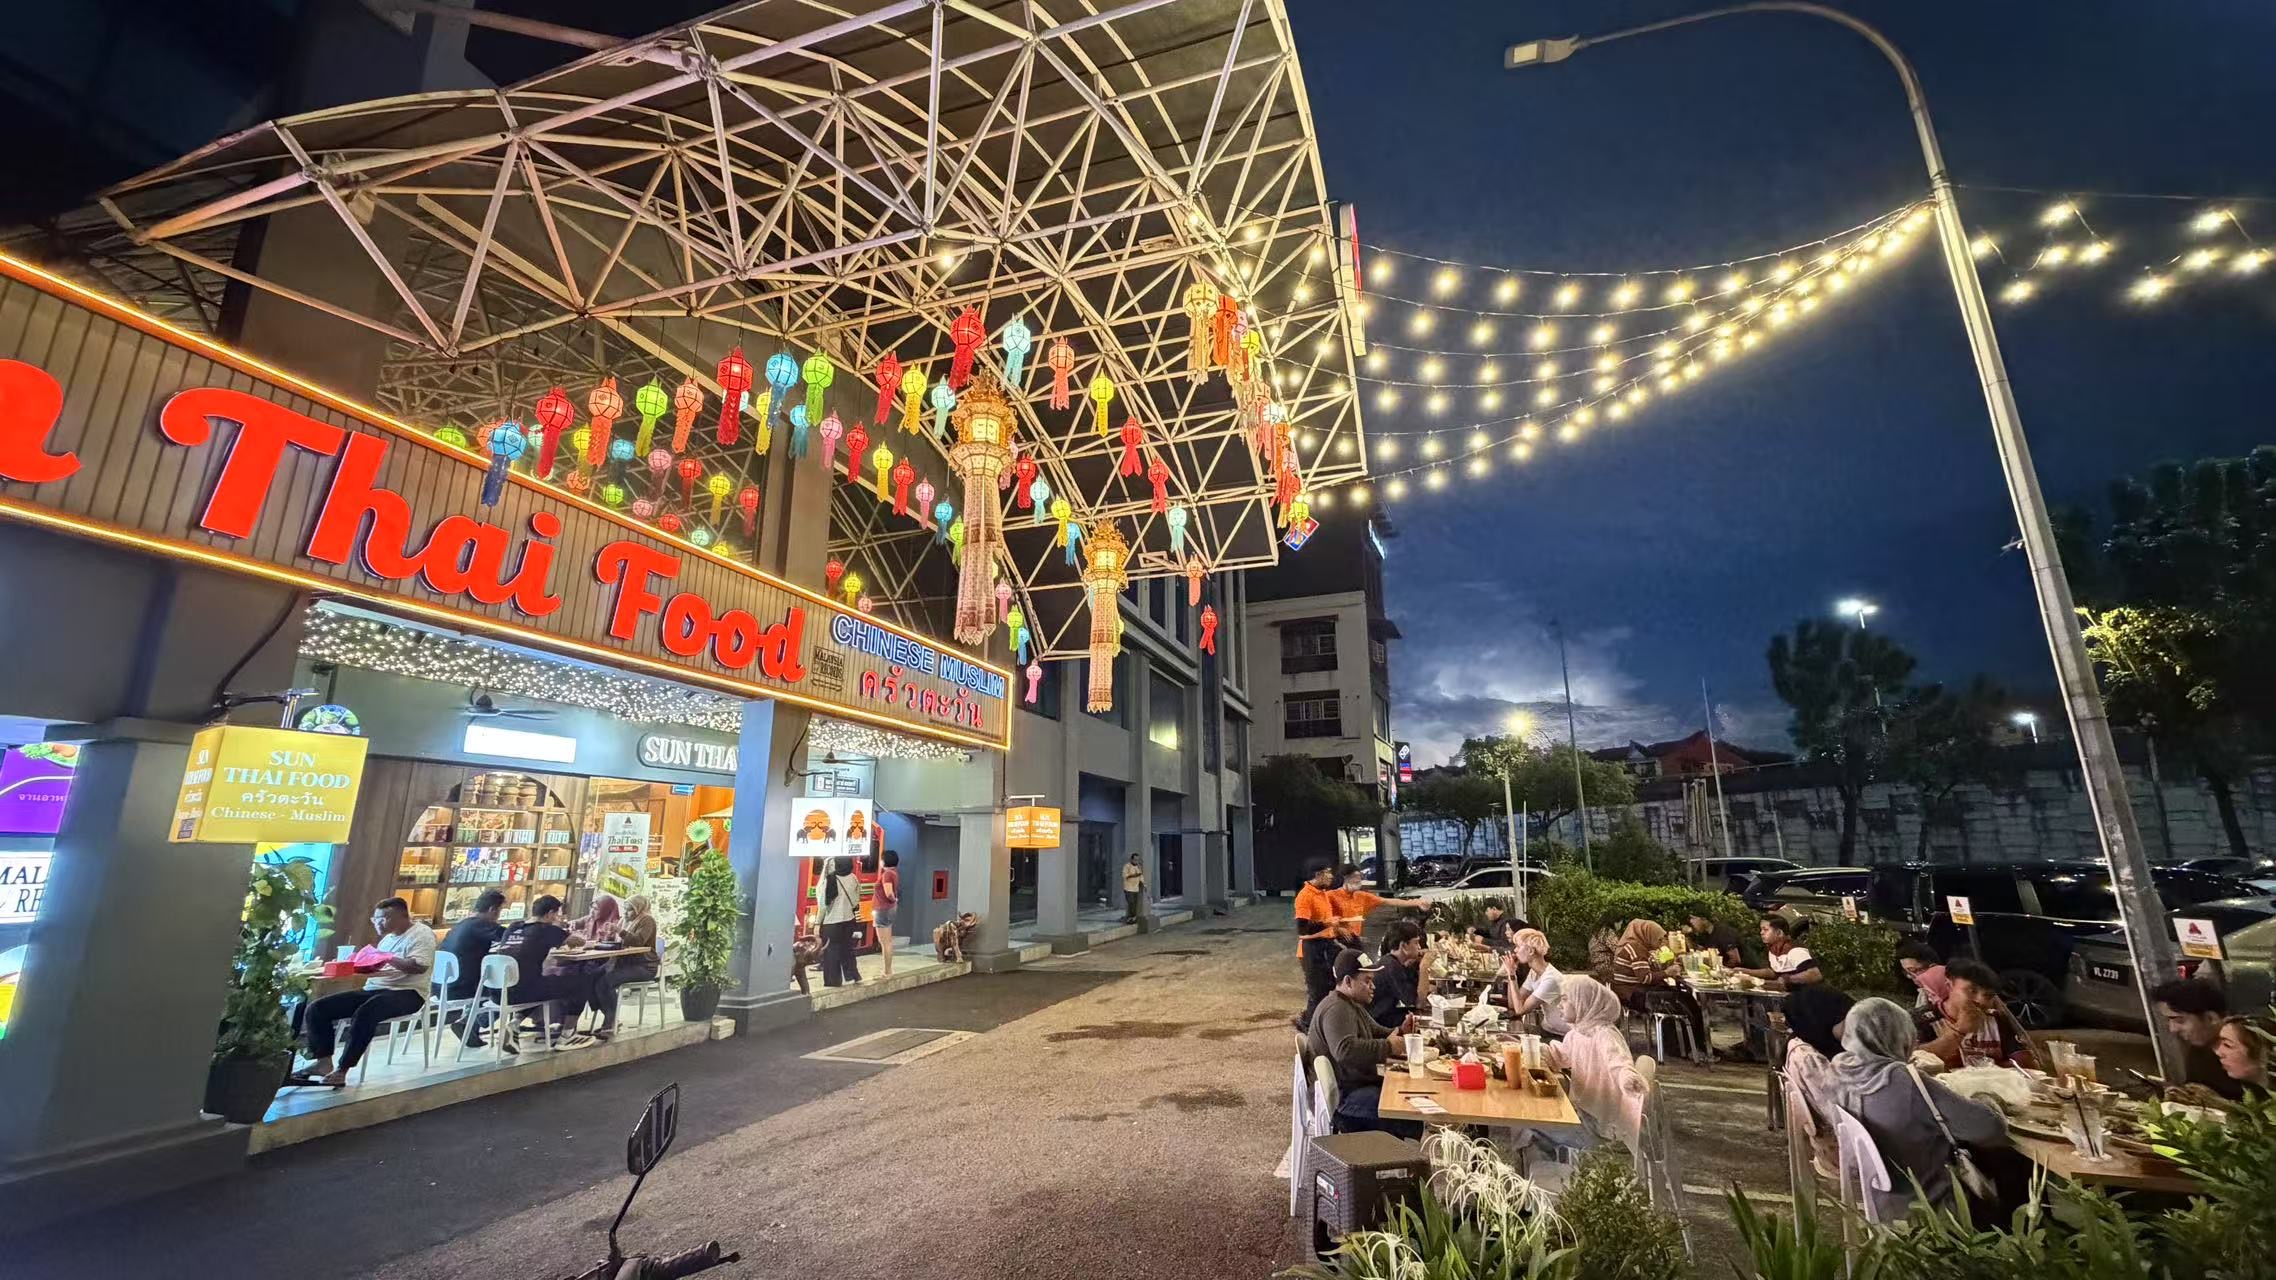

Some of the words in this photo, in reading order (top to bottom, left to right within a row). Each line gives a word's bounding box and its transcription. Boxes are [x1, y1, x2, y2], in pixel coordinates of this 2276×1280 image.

[160, 387, 561, 617] Thai
[594, 540, 807, 683] Food
[832, 613, 935, 675] CHINESE
[939, 652, 1006, 699] MUSLIM
[862, 664, 984, 729] ครัวตะวัน
[269, 750, 316, 768] SUN
[644, 736, 693, 766] SUN
[694, 743, 740, 771] THA
[223, 767, 282, 786] THAI
[287, 770, 351, 789] FOOD
[241, 789, 325, 806] ครัวตะวัน
[211, 806, 278, 821] Chinese
[289, 809, 346, 822] Muslim
